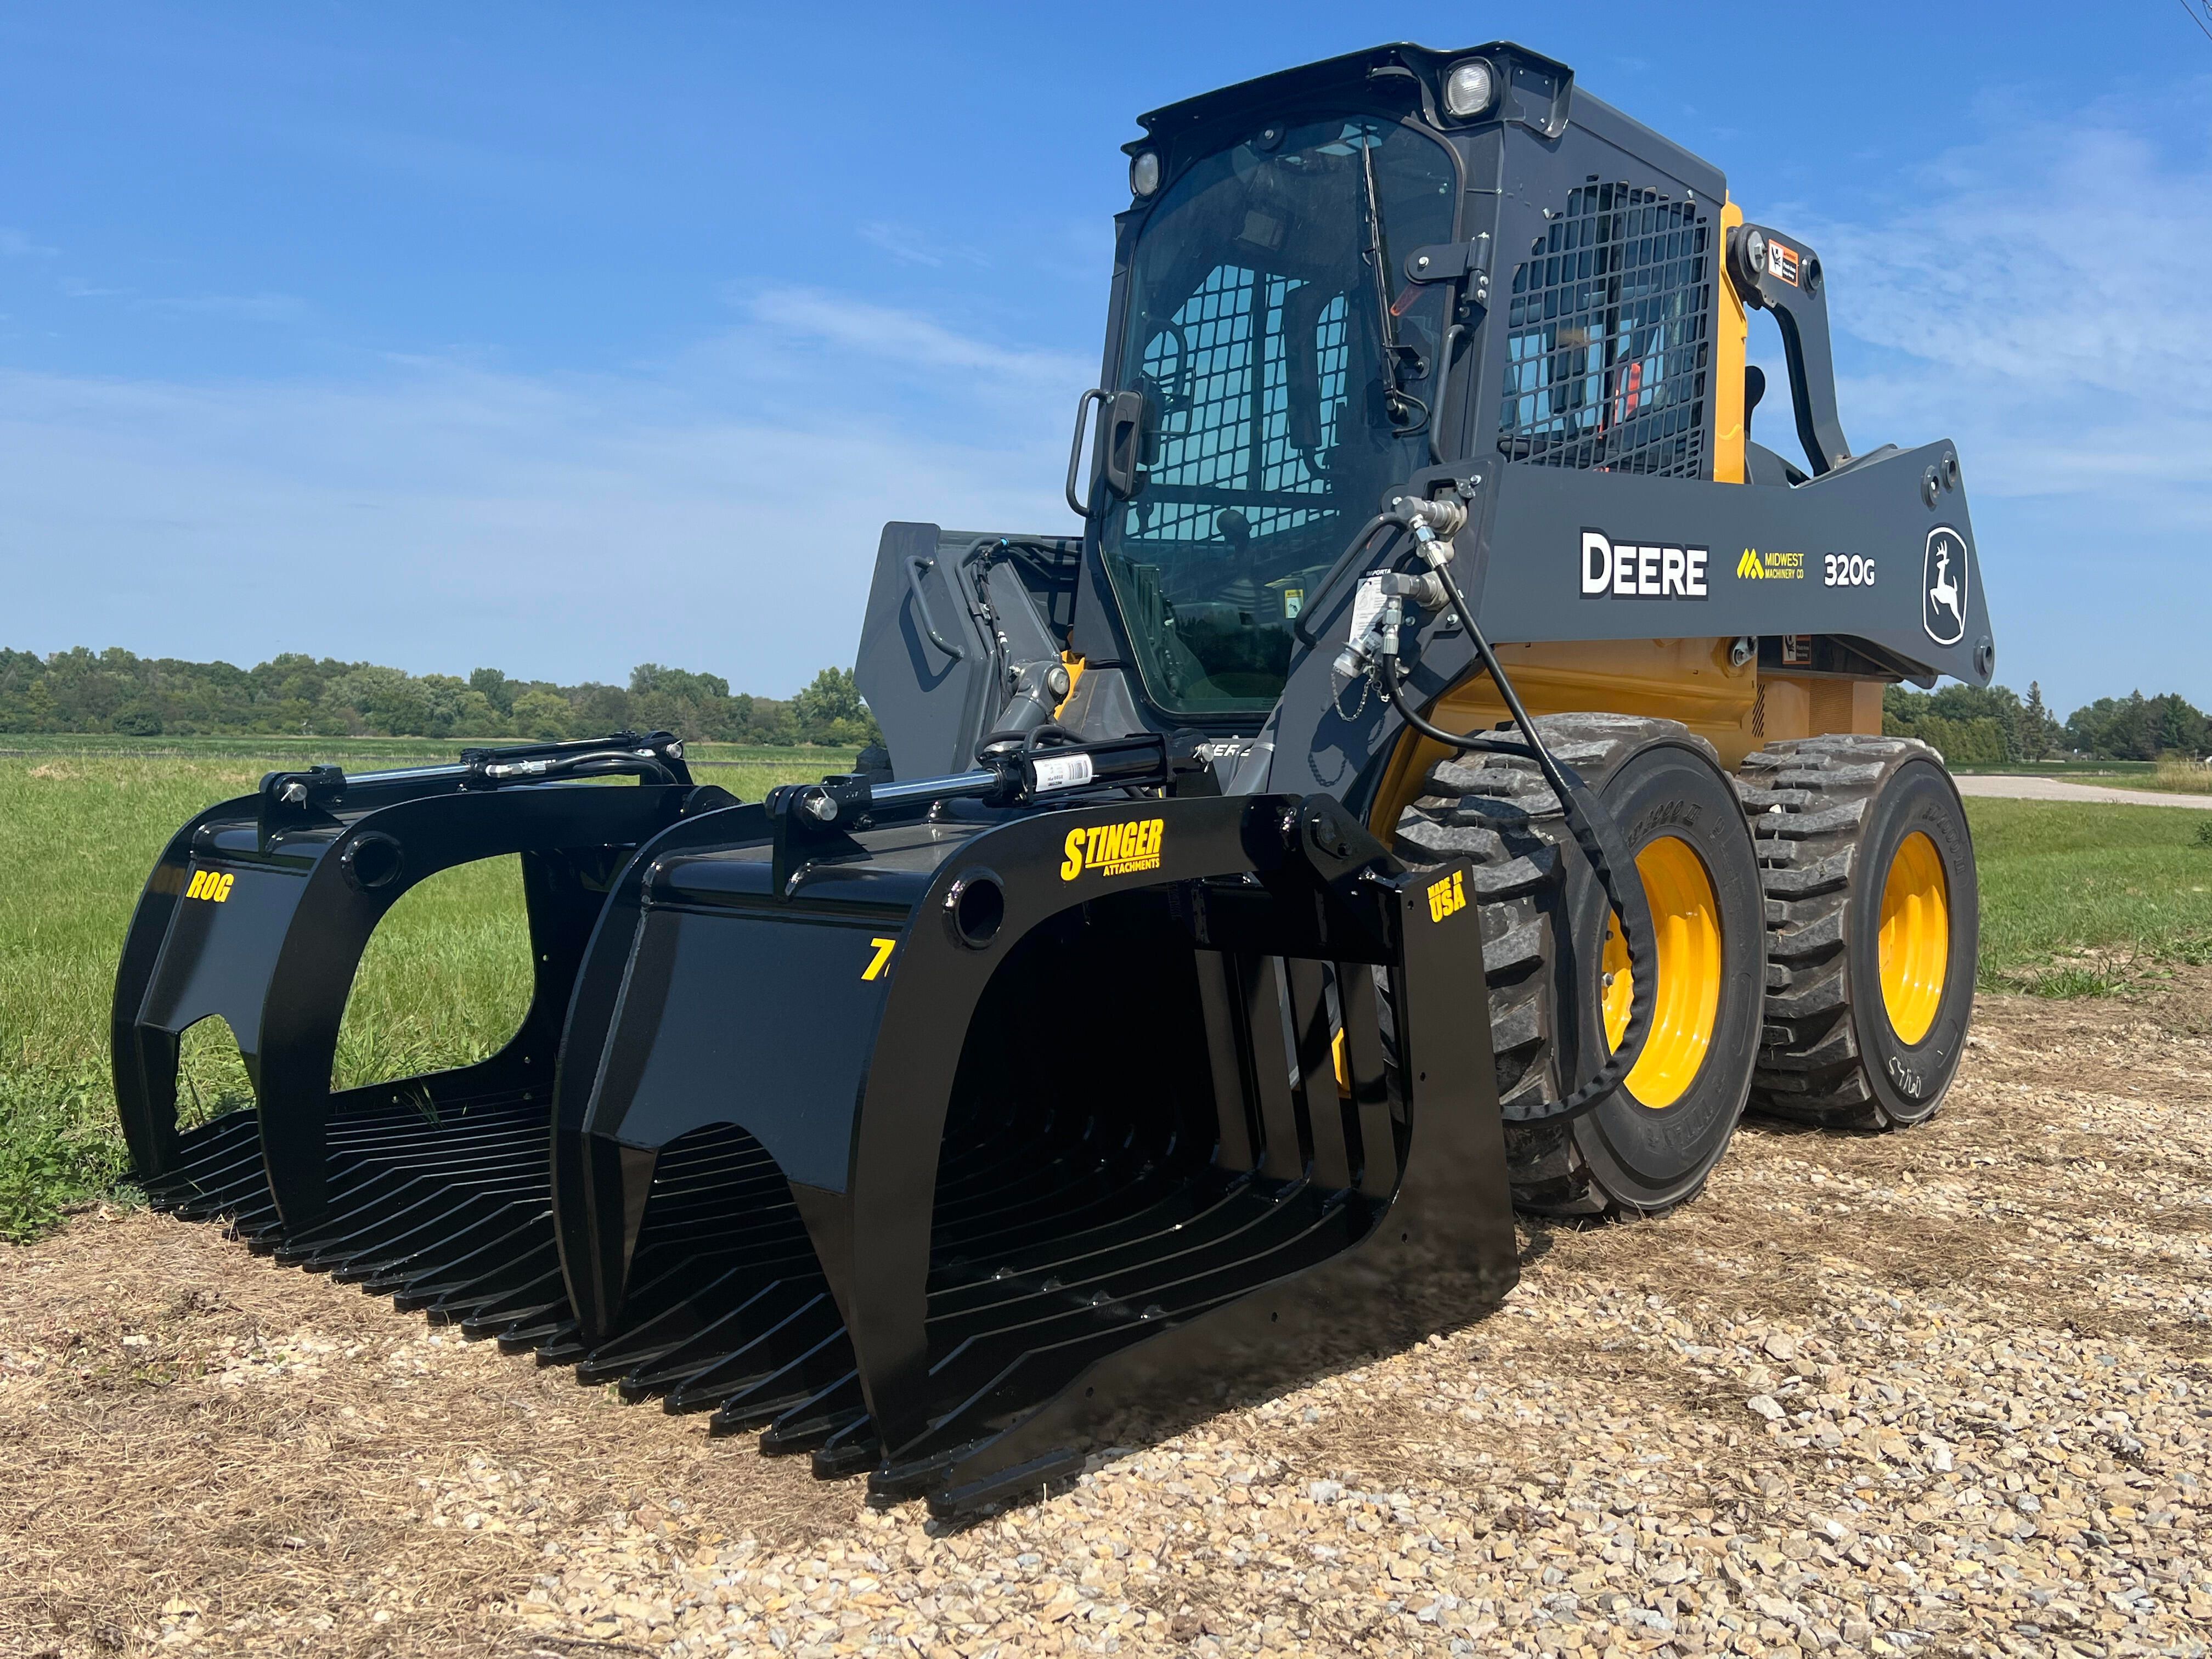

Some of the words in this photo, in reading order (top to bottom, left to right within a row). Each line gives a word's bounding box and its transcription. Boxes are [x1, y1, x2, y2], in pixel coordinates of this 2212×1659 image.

[1582, 532, 1707, 596] DEERE
[1765, 553, 1804, 567] MIDWEST
[1765, 568, 1795, 579] MACHINERY
[1796, 568, 1804, 579] CO
[1824, 554, 1875, 586] 320G
[1060, 819, 1164, 881] STINGER
[1103, 858, 1160, 877] ATTACHMENTS
[185, 870, 234, 902] ROG
[1426, 877, 1451, 899] MADE
[1452, 870, 1463, 885] IN
[1429, 883, 1466, 923] USA
[861, 938, 896, 981] 7
